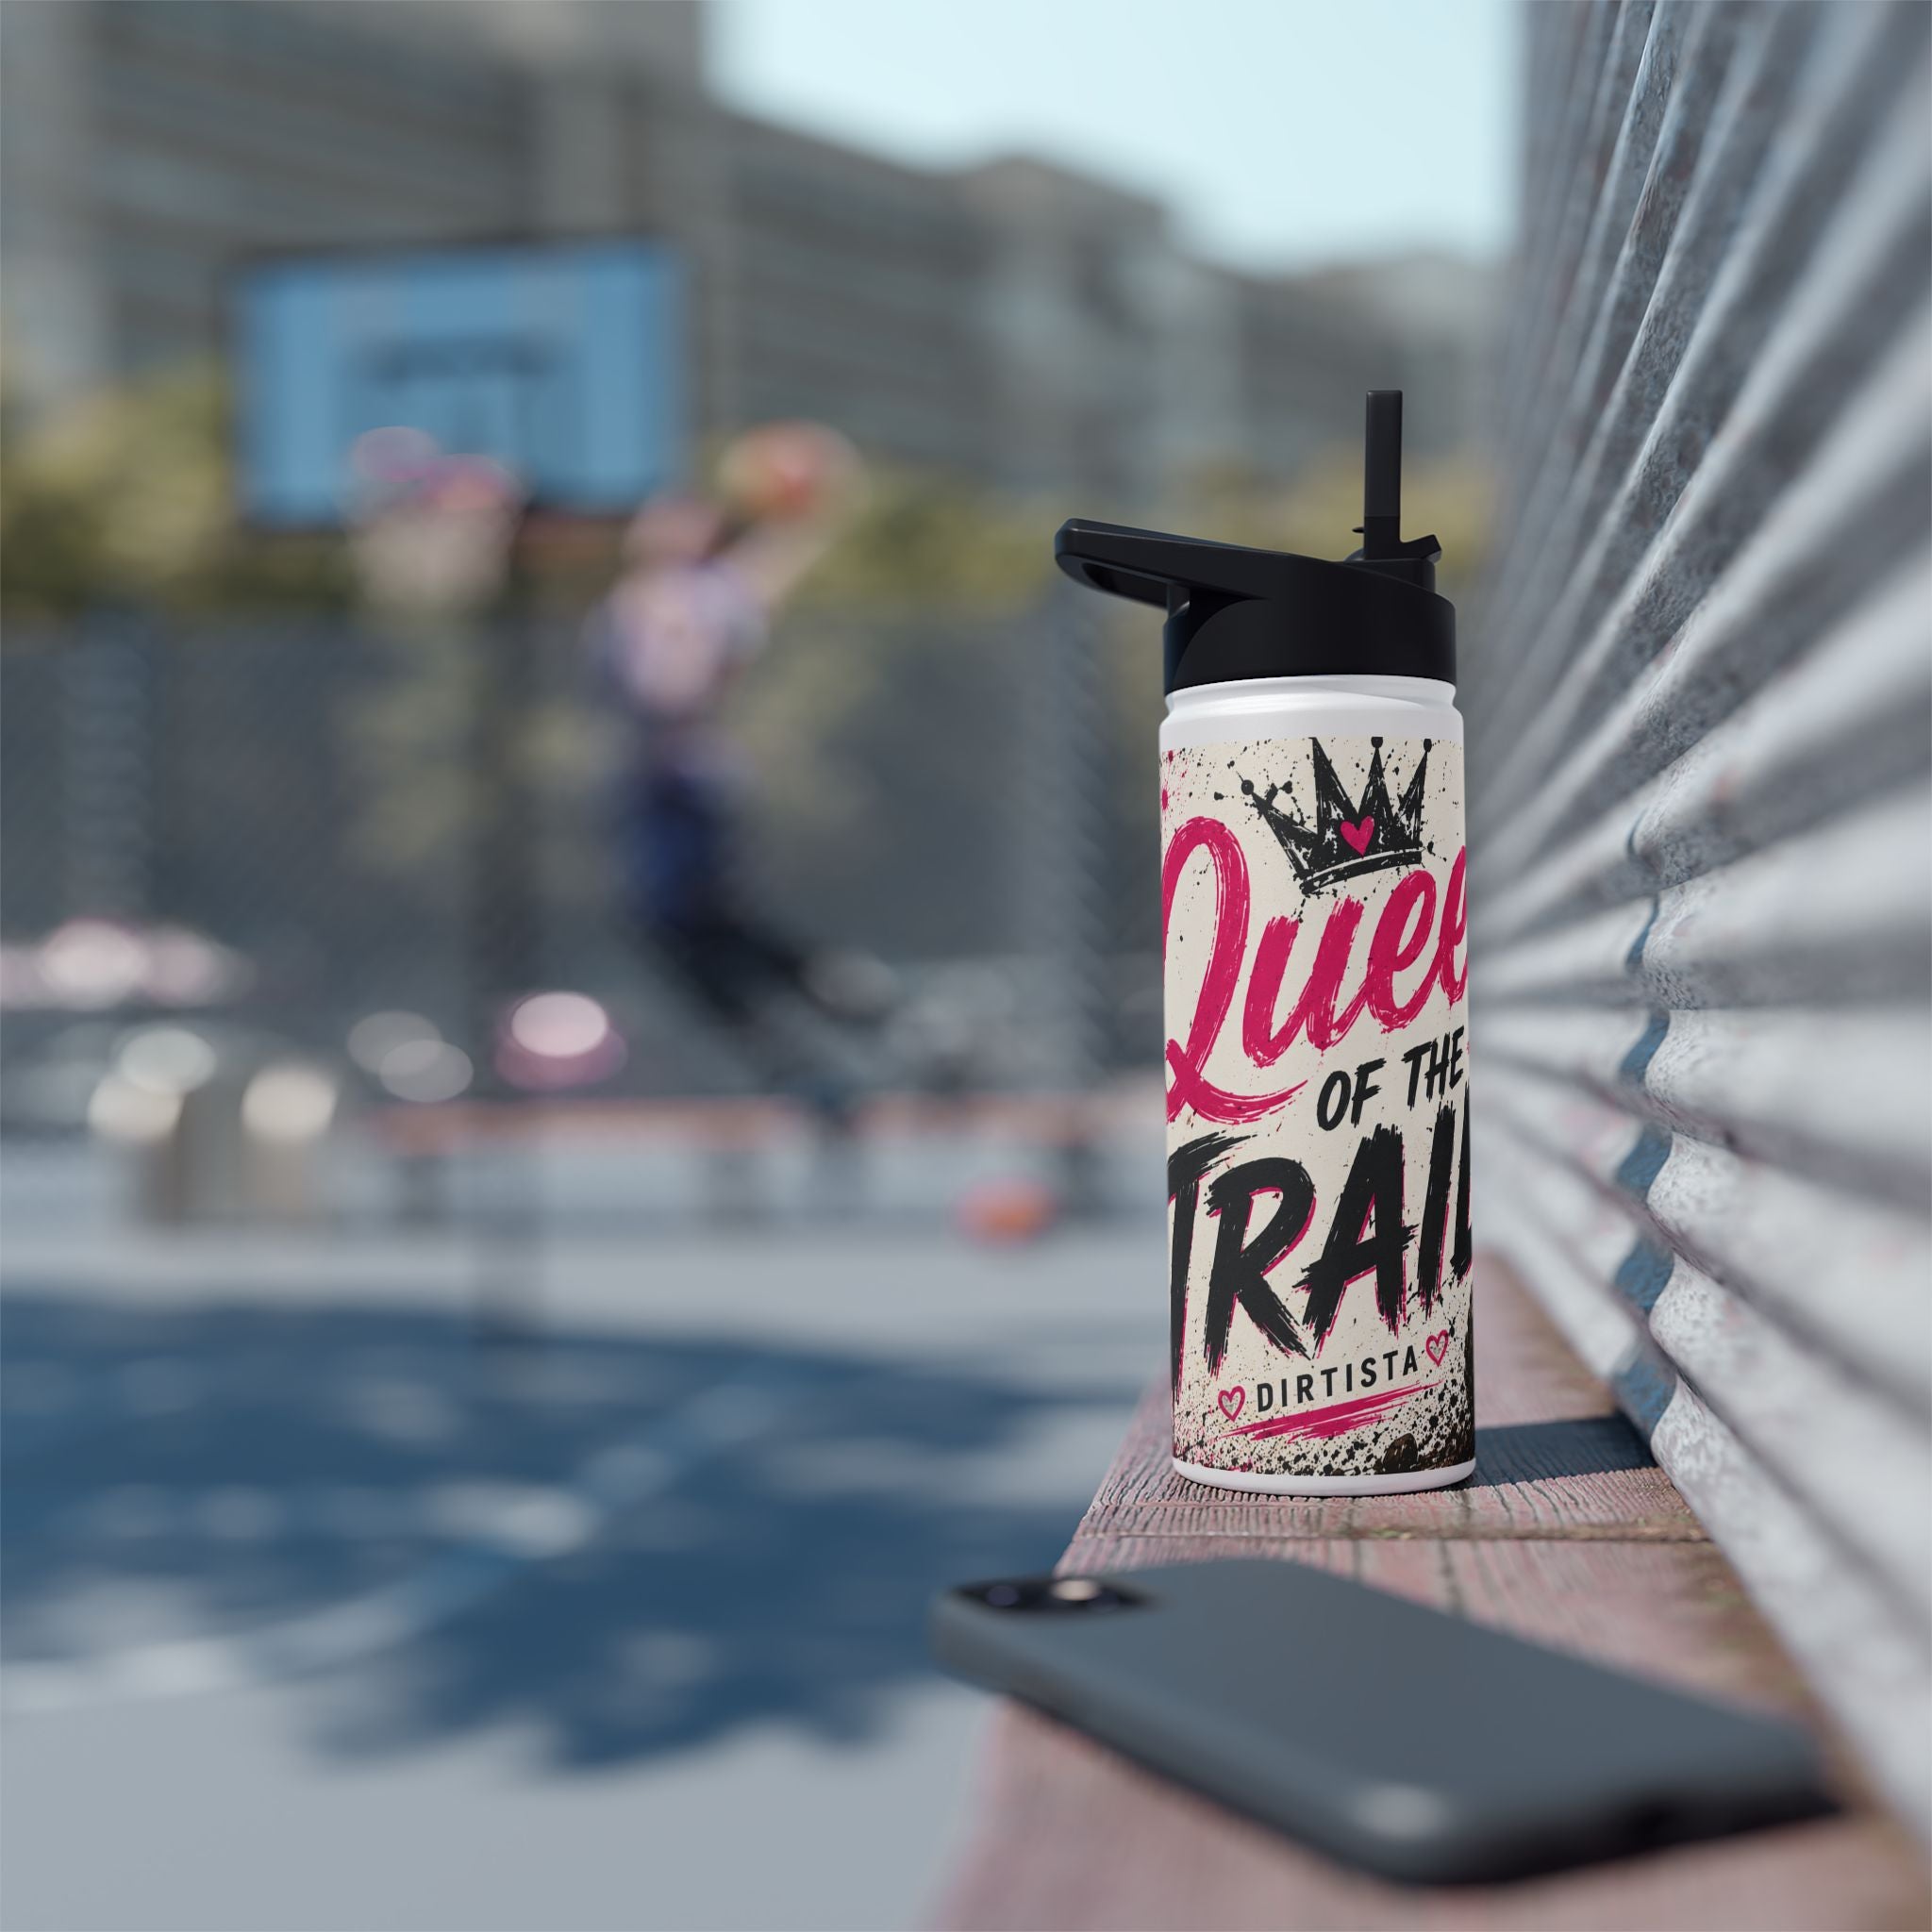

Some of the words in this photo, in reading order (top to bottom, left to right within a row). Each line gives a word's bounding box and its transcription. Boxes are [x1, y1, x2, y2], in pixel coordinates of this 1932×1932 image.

[1317, 1058, 1386, 1131] OF
[1402, 1025, 1465, 1110] THE
[1257, 1345, 1419, 1413] DIRTISTA
